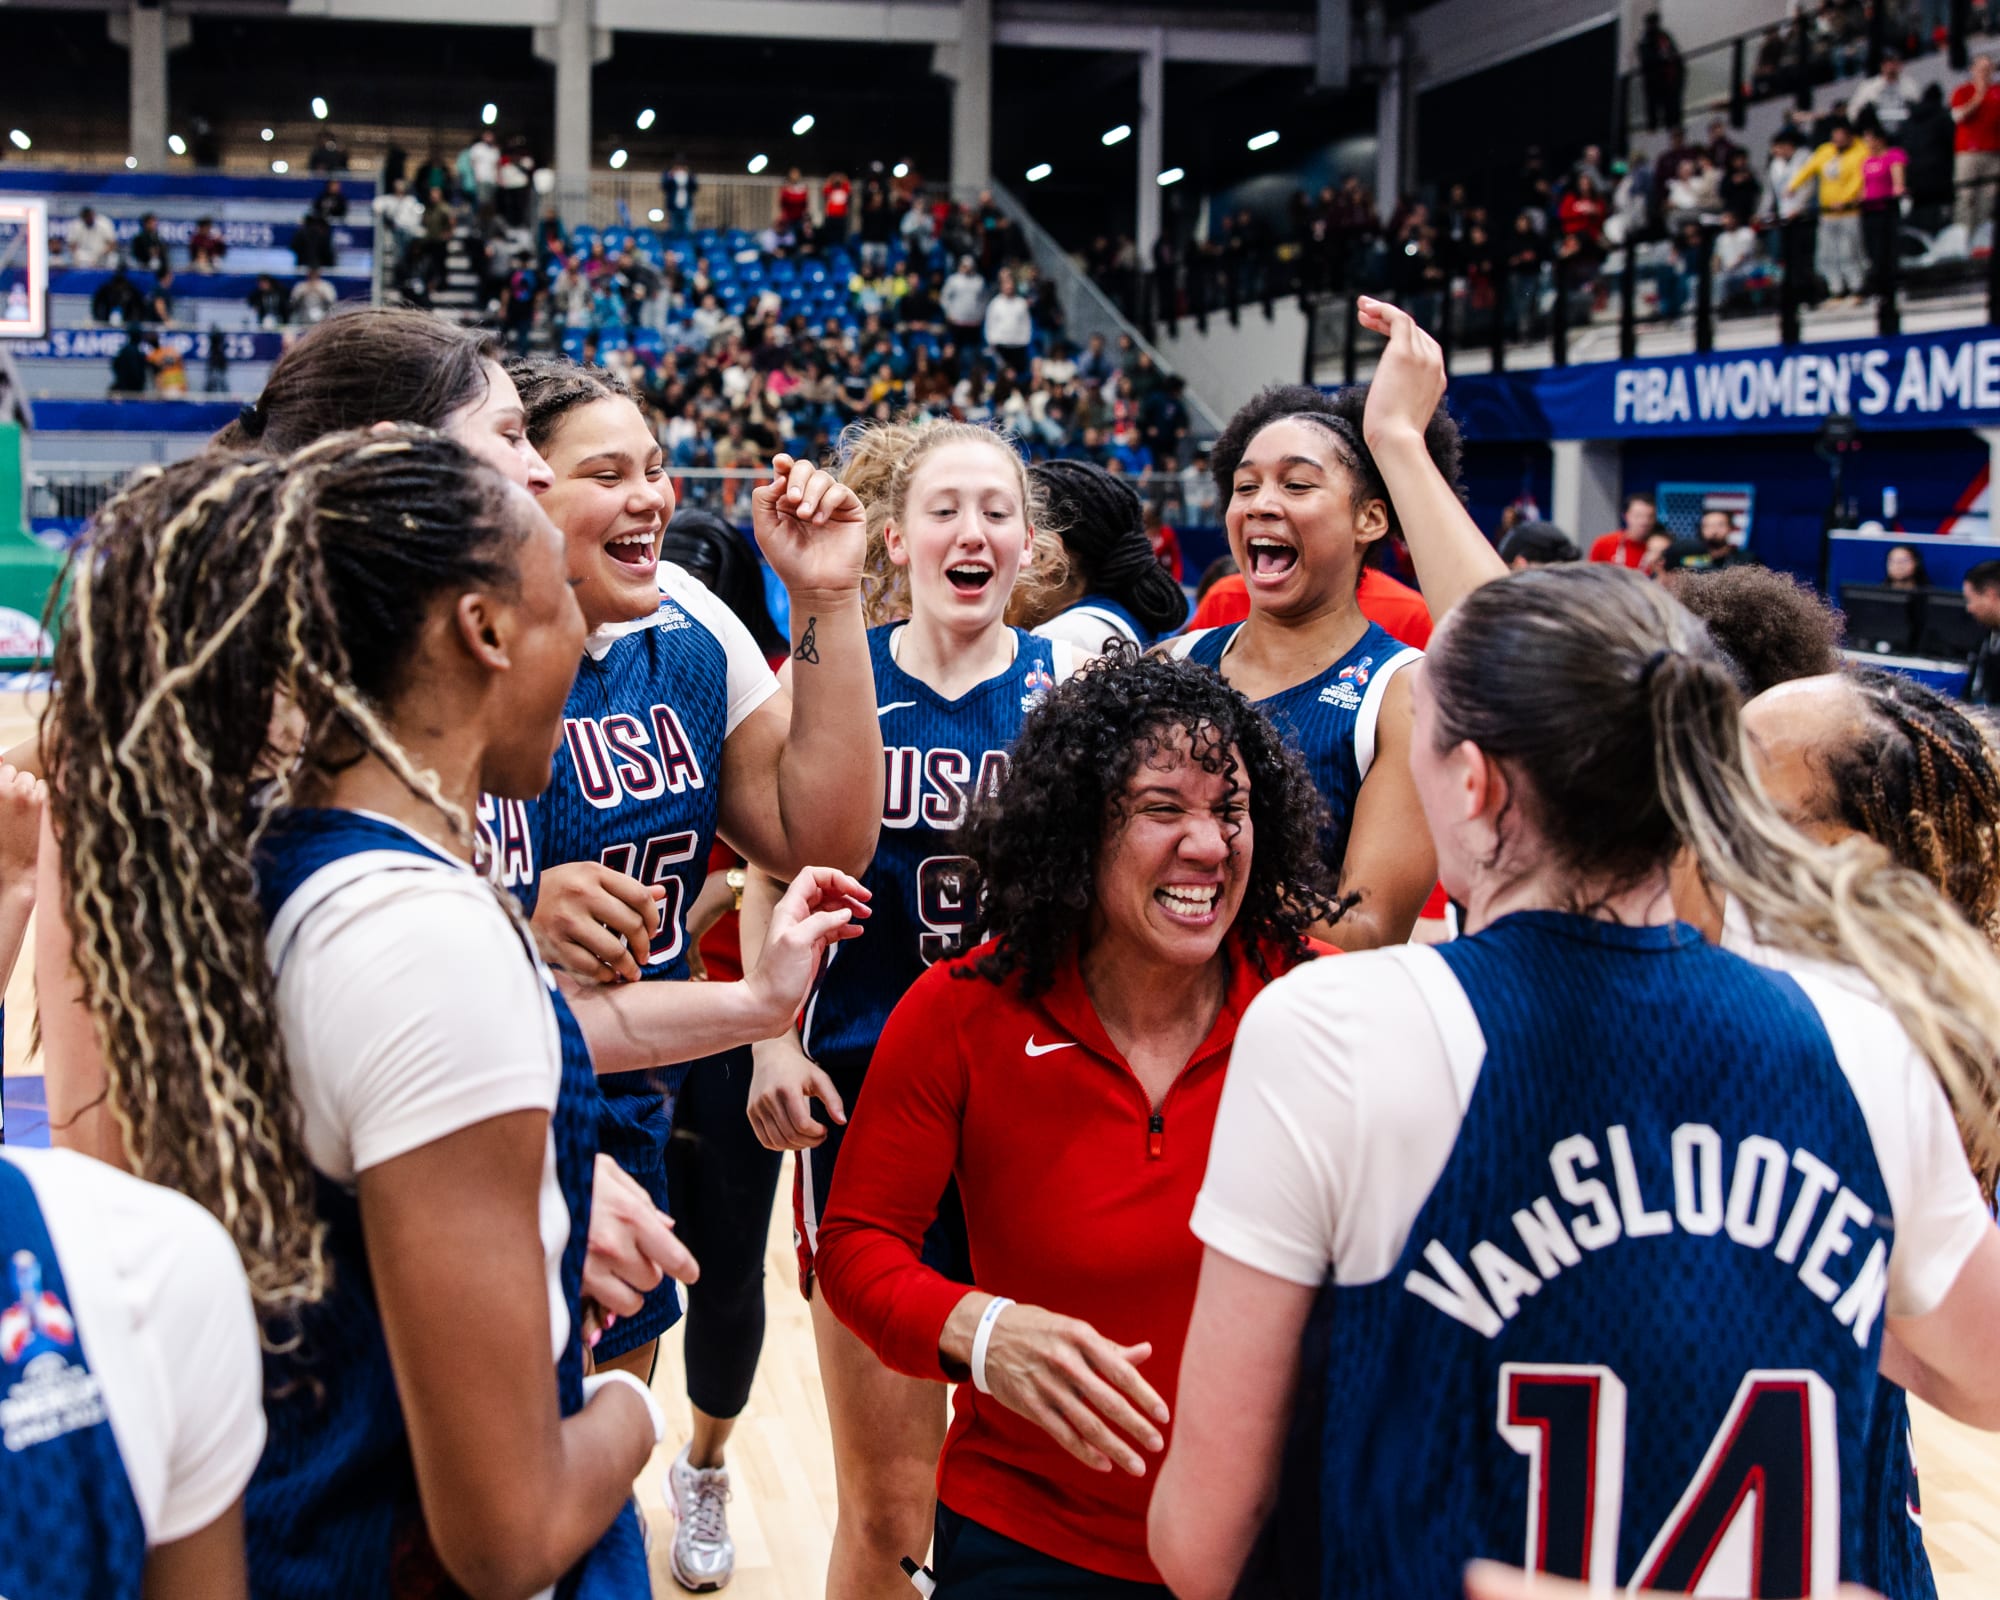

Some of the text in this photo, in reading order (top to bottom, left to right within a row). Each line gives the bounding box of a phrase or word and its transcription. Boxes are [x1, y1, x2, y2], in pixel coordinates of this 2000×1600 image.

[196, 335, 255, 359] 225
[1614, 367, 1691, 423] FIBA
[1694, 349, 1889, 421] WOMEN'S
[1318, 695, 1340, 706] CHILE
[563, 703, 705, 809] USA
[882, 746, 1012, 831] USA
[916, 855, 992, 968] 9
[1497, 1362, 1840, 1598] 14
